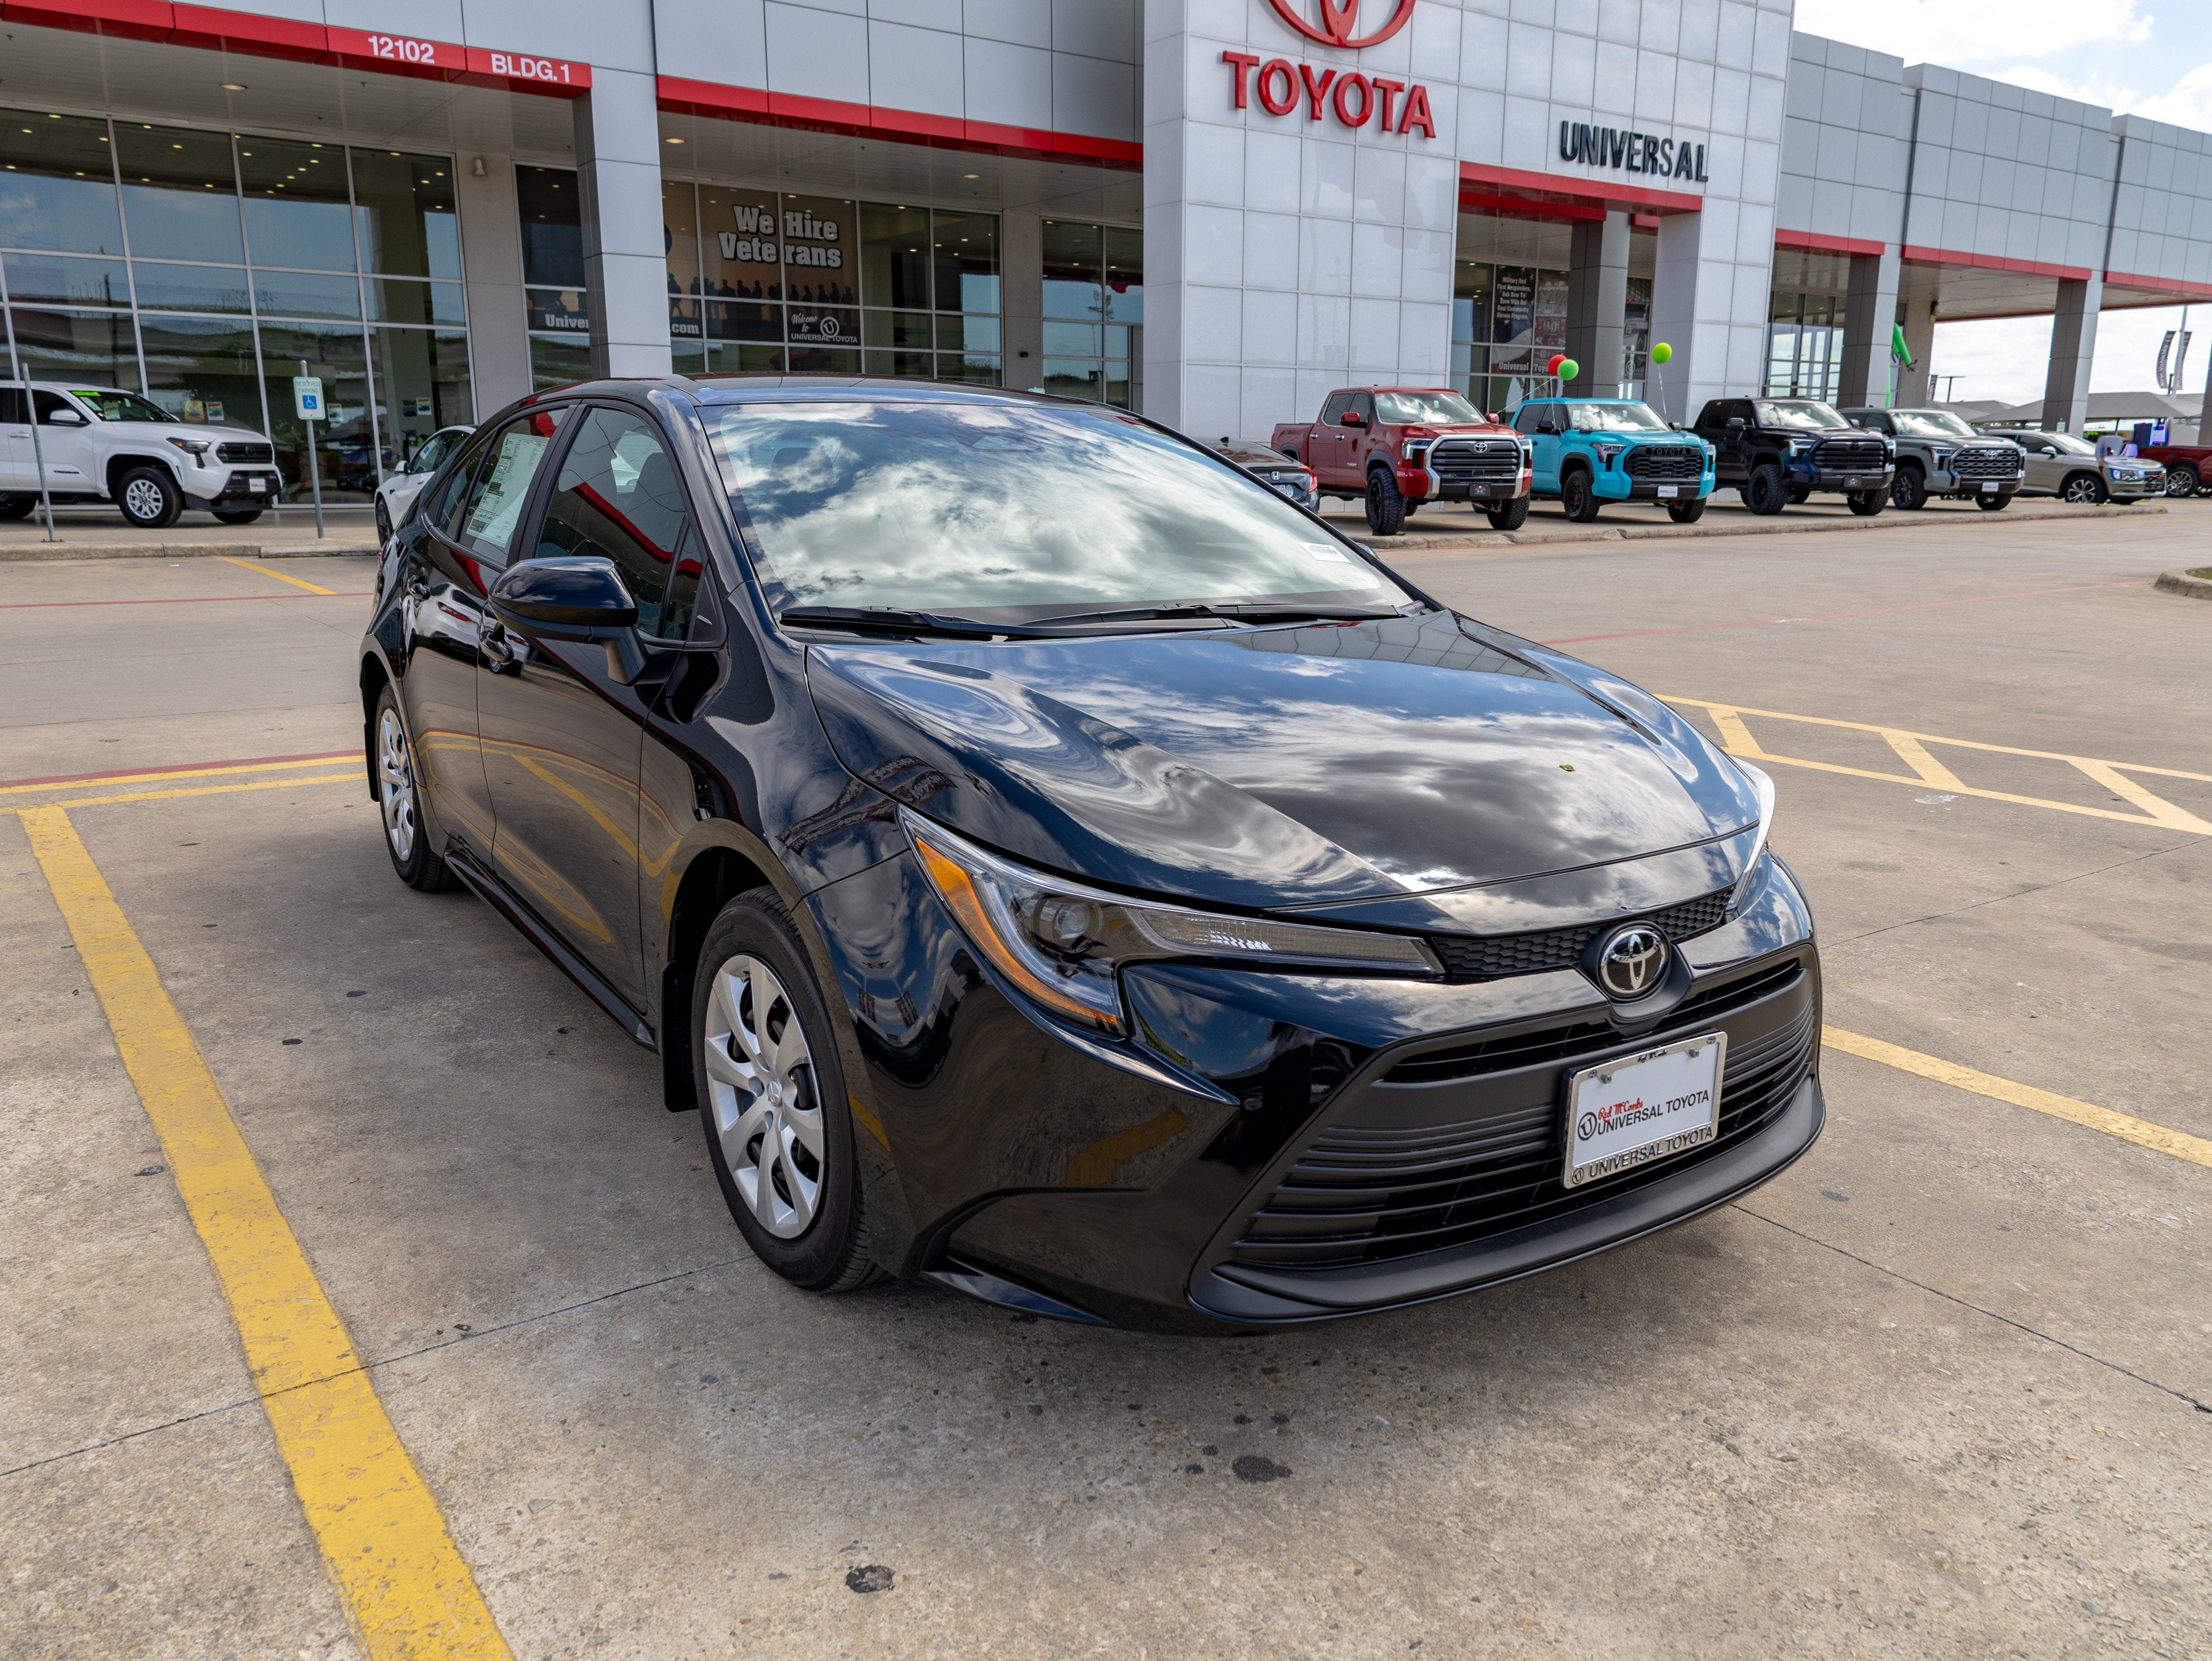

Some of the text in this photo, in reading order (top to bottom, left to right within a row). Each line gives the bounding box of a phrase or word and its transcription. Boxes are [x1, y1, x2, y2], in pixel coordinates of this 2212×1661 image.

[368, 35, 435, 65] 12102
[1222, 50, 1436, 138] TOYOTA
[1560, 120, 1709, 183] UNIVERSAL
[733, 205, 839, 241] We Hire
[718, 232, 843, 268] Veterans
[544, 314, 589, 328] Univer
[791, 312, 818, 324] Welcome
[801, 323, 810, 332] to
[791, 333, 830, 341] UNIVERSAL
[1499, 361, 1548, 373] Universal Toyo
[1597, 1089, 1709, 1135] UNIVERSAL TOYOTA
[1598, 1106, 1612, 1123] Red
[1589, 1125, 1713, 1178] UNIVERSAL TOYOTA
